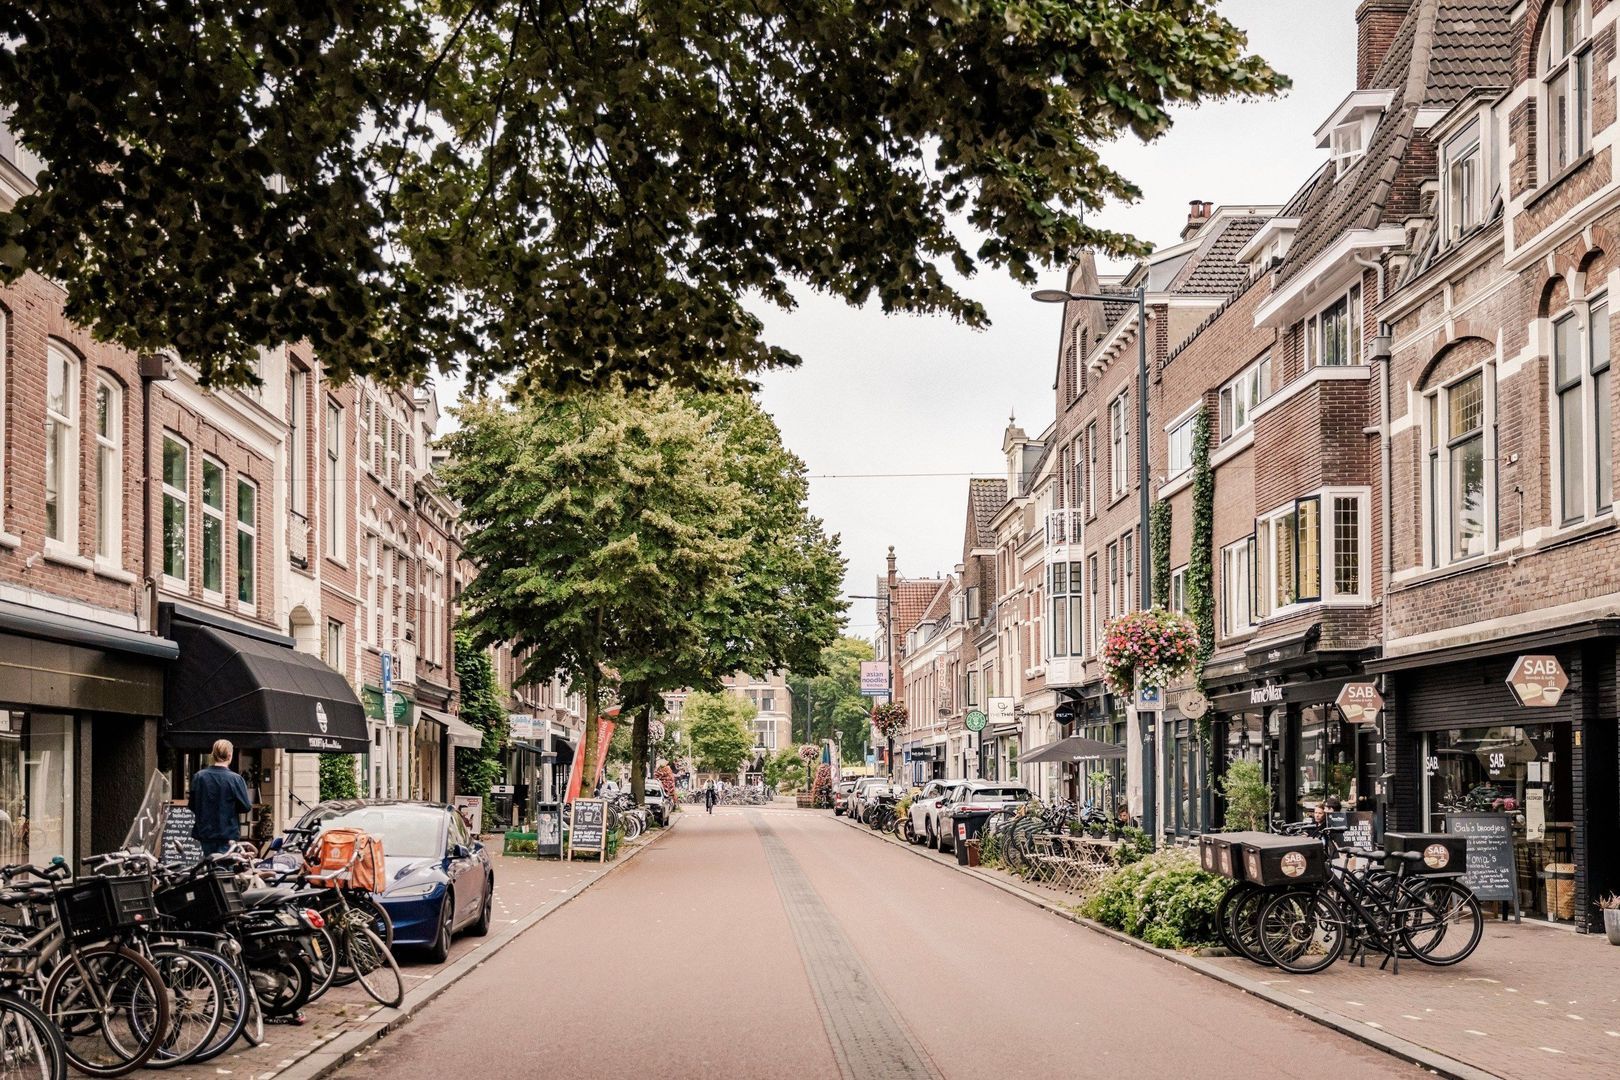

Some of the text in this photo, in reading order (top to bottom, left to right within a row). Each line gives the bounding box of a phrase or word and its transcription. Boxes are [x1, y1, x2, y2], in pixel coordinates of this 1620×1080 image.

[1523, 660, 1560, 675] SAB.
[1348, 686, 1377, 698] SAB.
[1425, 756, 1439, 770] SAB.
[1489, 753, 1506, 768] SAB.
[1455, 822, 1506, 834] Sab's broodjes
[1284, 854, 1304, 863] SAB.
